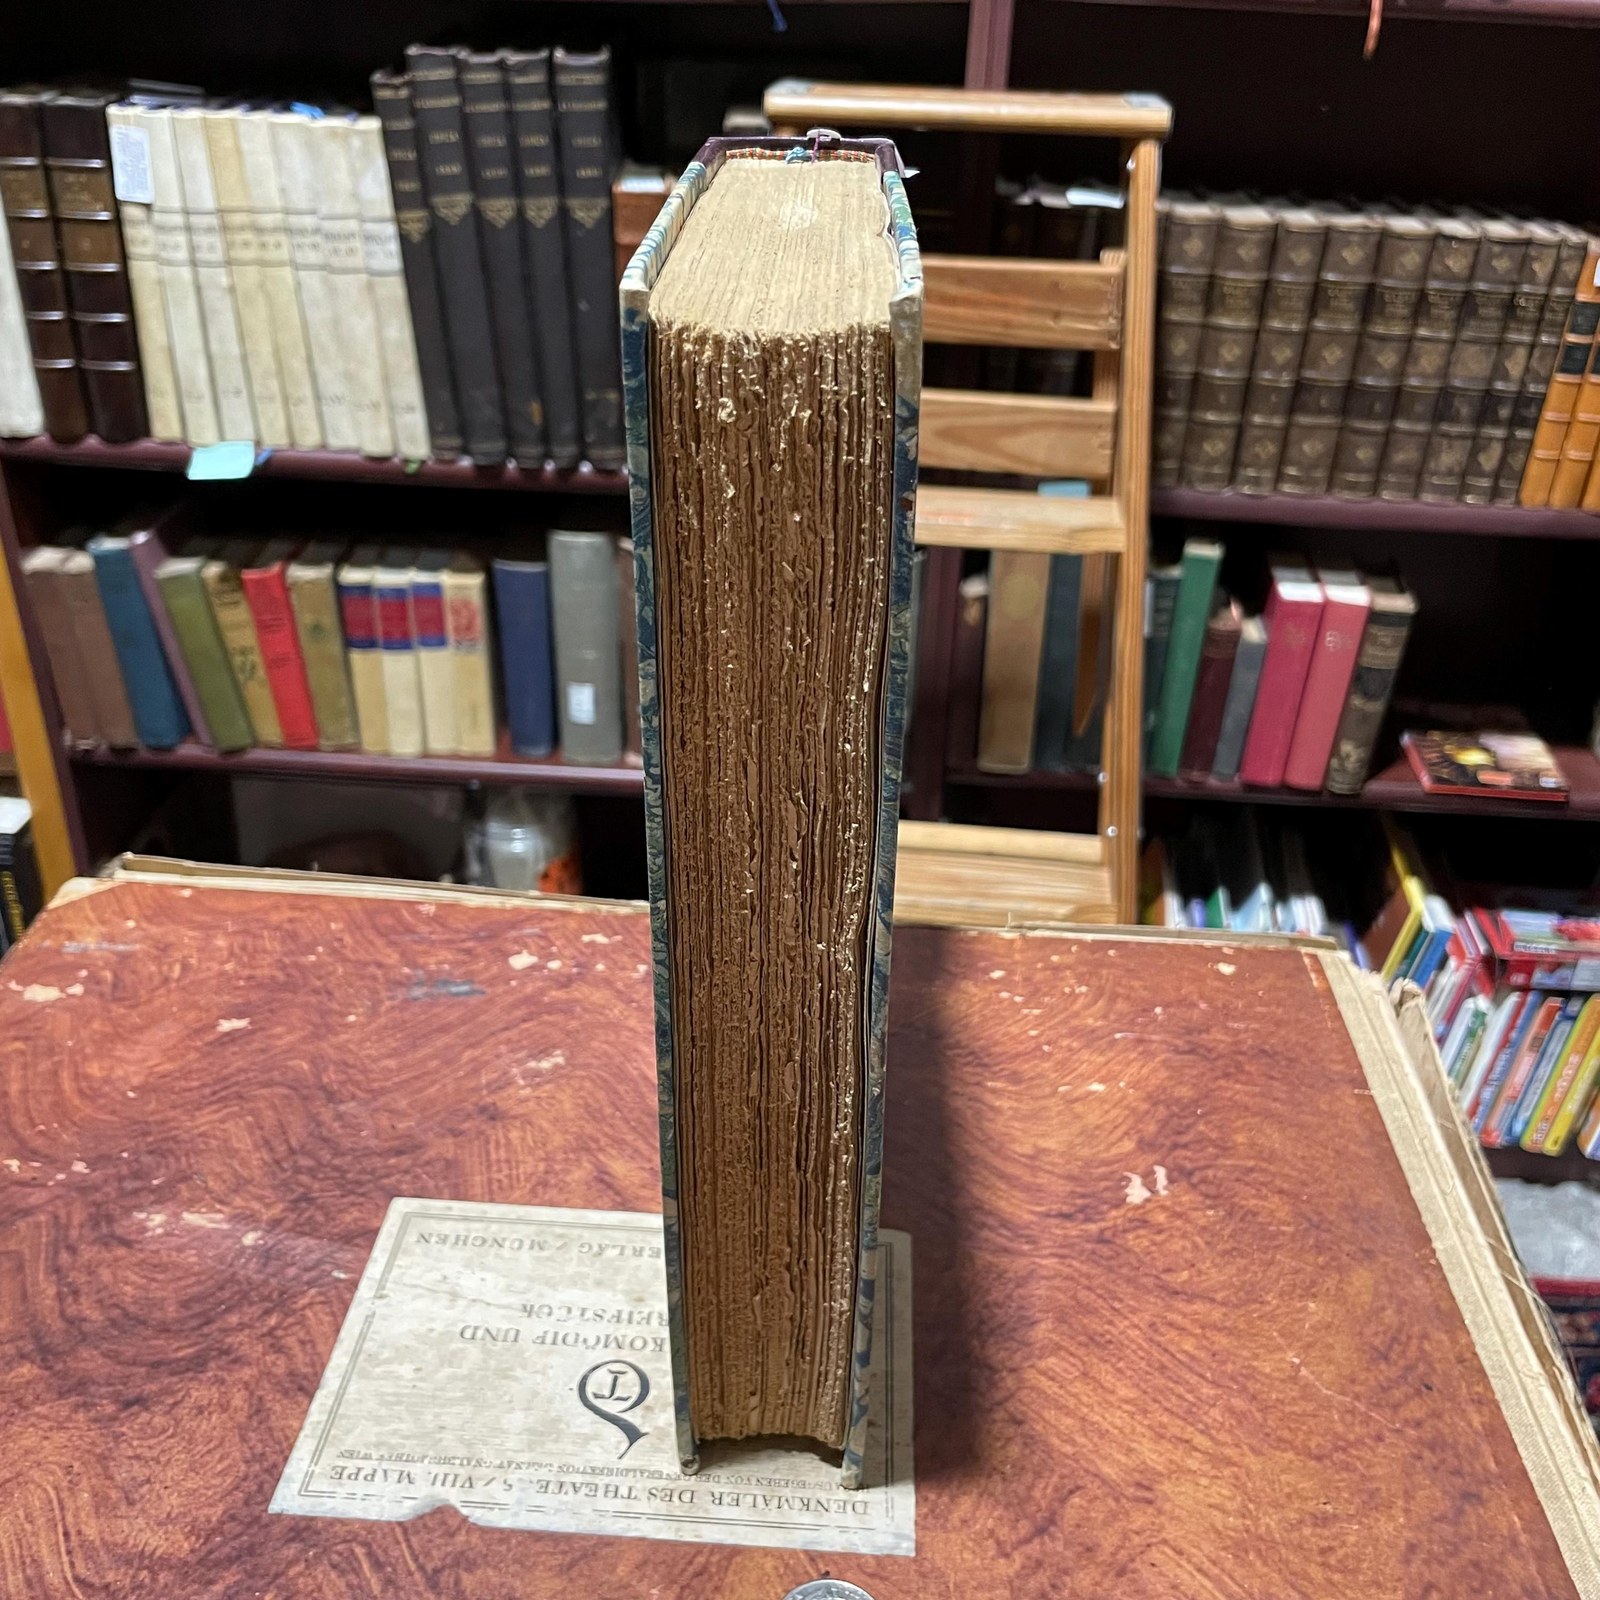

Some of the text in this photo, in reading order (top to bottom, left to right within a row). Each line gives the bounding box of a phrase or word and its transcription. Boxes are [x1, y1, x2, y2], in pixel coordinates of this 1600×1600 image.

[413, 1231, 549, 1253] MÜNCHEN
[576, 1241, 662, 1260] ERLAG
[459, 1323, 521, 1343] UND
[329, 1464, 415, 1486] MAPPE
[724, 1474, 751, 1486] VON
[502, 1476, 638, 1502] THEATES
[647, 1487, 696, 1507] DES
[710, 1490, 870, 1514] DENKMÄLER
